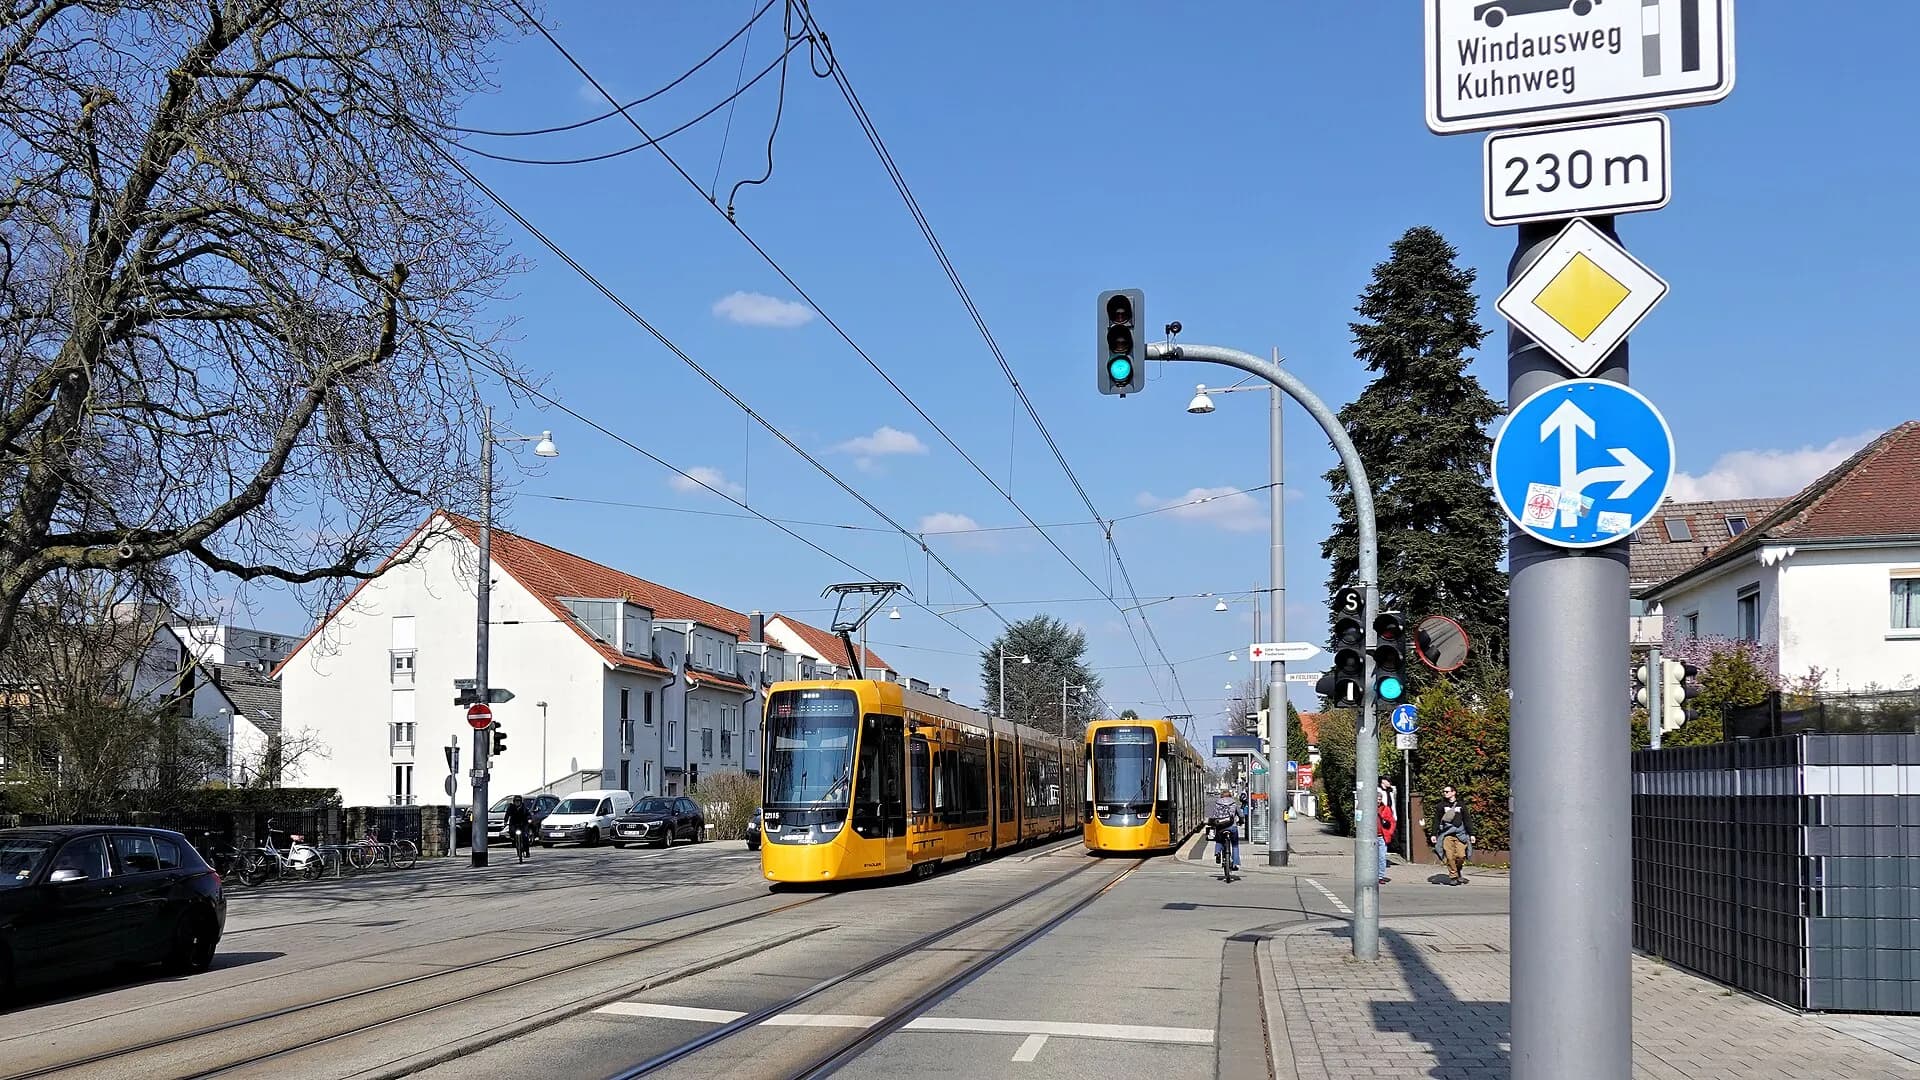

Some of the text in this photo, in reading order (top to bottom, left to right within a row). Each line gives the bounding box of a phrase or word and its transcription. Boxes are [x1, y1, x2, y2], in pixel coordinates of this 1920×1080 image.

[1457, 25, 1622, 66] Windausweg
[1457, 66, 1576, 101] Kuhnweg
[1504, 149, 1649, 197] 230 m
[1345, 593, 1358, 610] S
